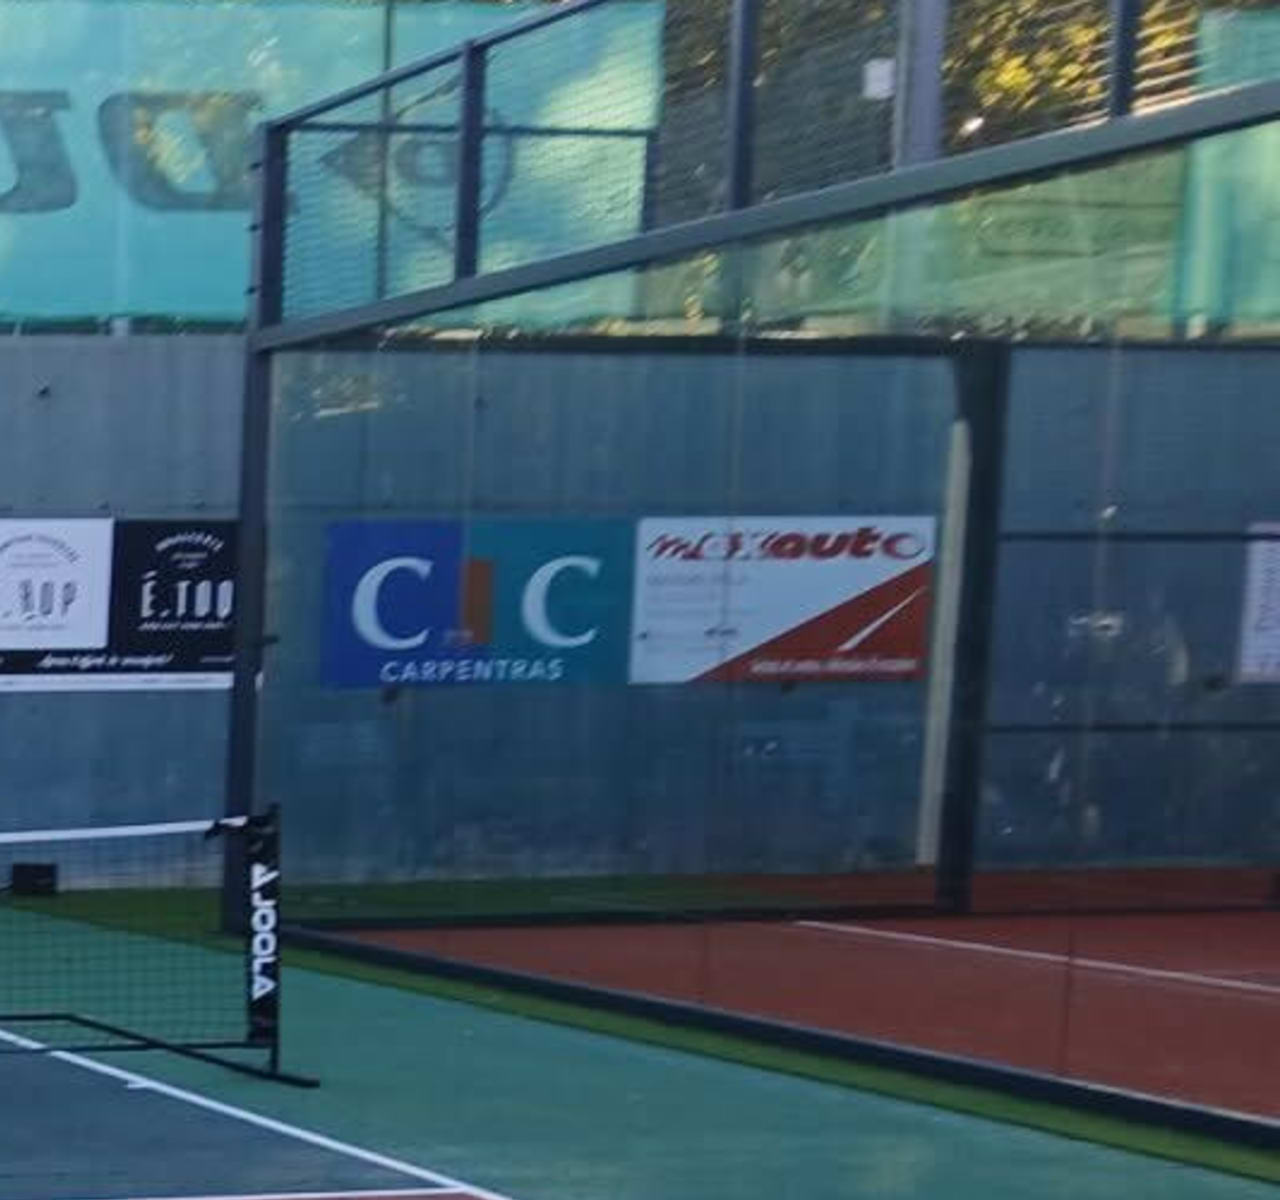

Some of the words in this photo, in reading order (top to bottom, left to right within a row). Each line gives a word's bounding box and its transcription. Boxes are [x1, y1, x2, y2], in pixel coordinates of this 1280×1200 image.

[352, 556, 601, 650] CIC
[381, 659, 563, 682] CARPENTRAS
[251, 891, 277, 1000] JOOLA
